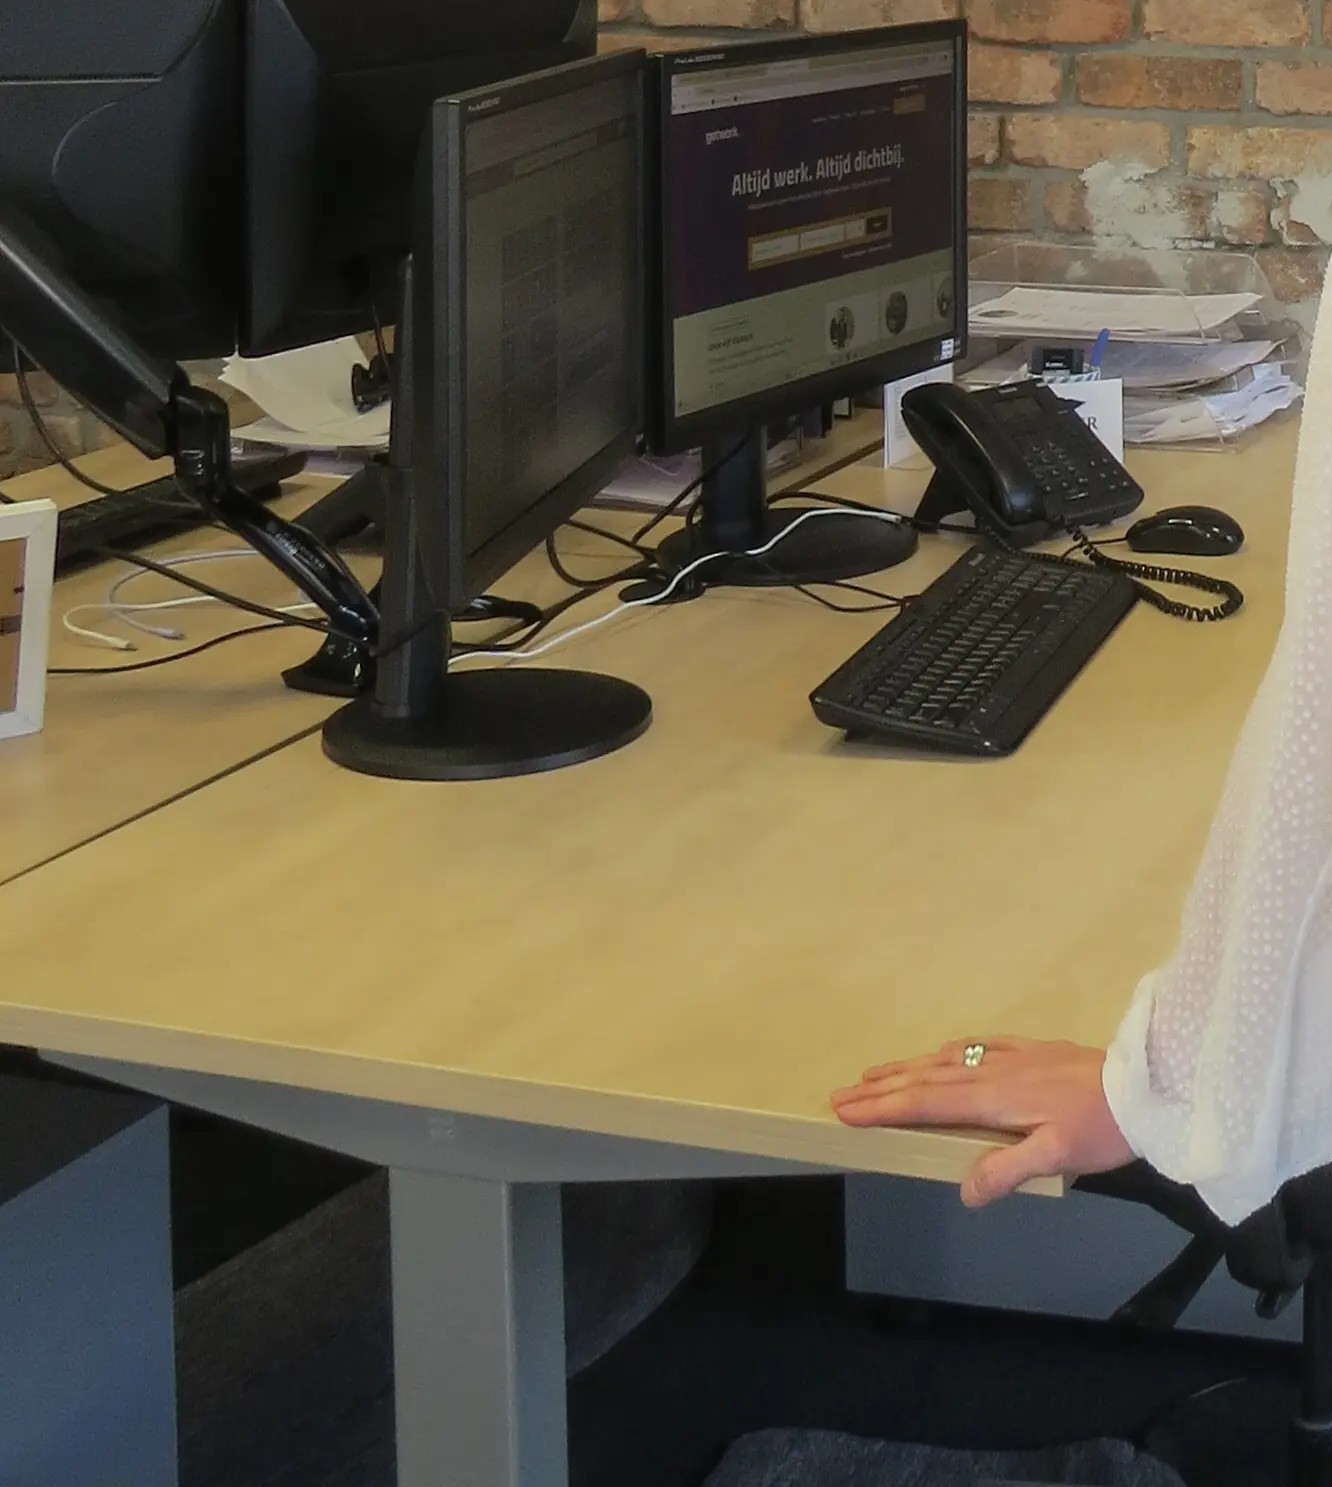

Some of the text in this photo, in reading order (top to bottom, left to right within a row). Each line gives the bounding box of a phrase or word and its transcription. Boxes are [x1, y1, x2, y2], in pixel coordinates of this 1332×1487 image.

[731, 168, 770, 197] Altijd
[774, 161, 812, 189] werk.
[815, 152, 851, 182] Altijd
[854, 144, 905, 172] dichtbij.
